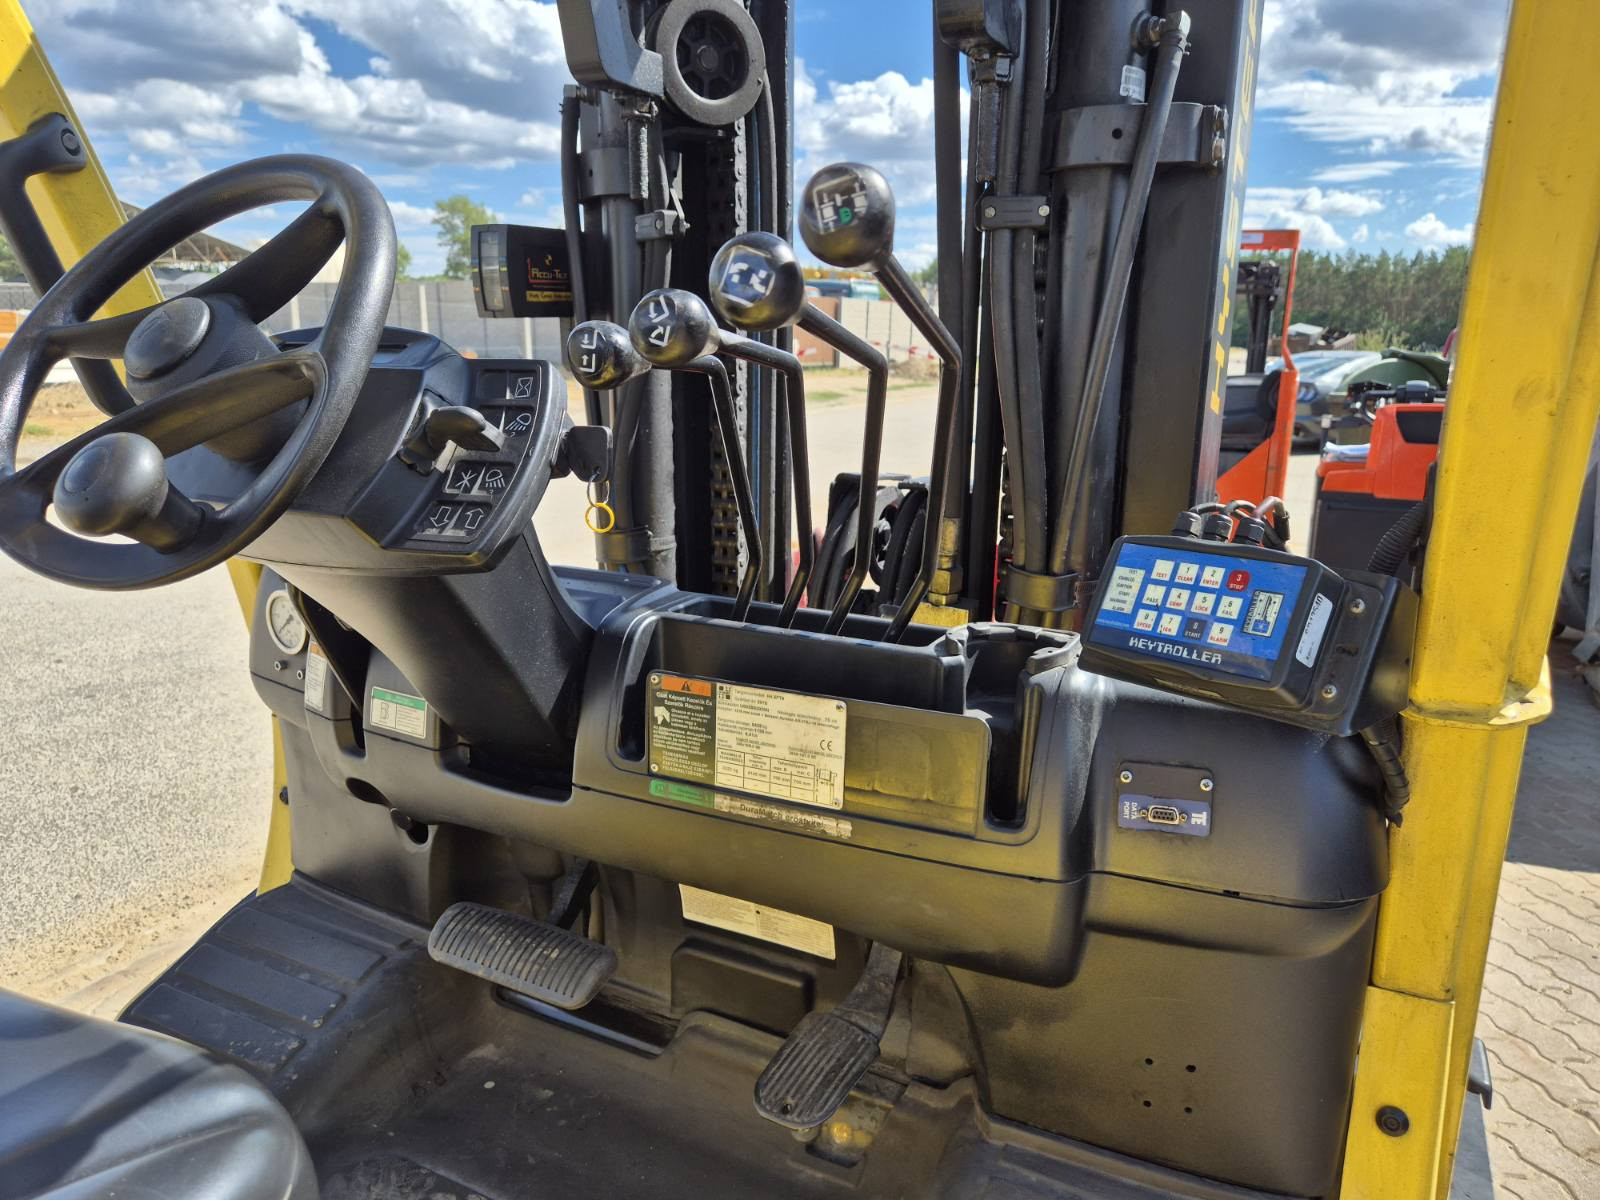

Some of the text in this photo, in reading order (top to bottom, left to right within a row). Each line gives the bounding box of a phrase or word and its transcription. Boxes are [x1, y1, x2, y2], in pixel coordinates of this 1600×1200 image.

[1229, 583, 1244, 591] STOP
[1185, 630, 1200, 638] START
[1209, 635, 1228, 643] ALARM
[1128, 636, 1222, 665] KEYTROLLER
[820, 739, 832, 752] CE
